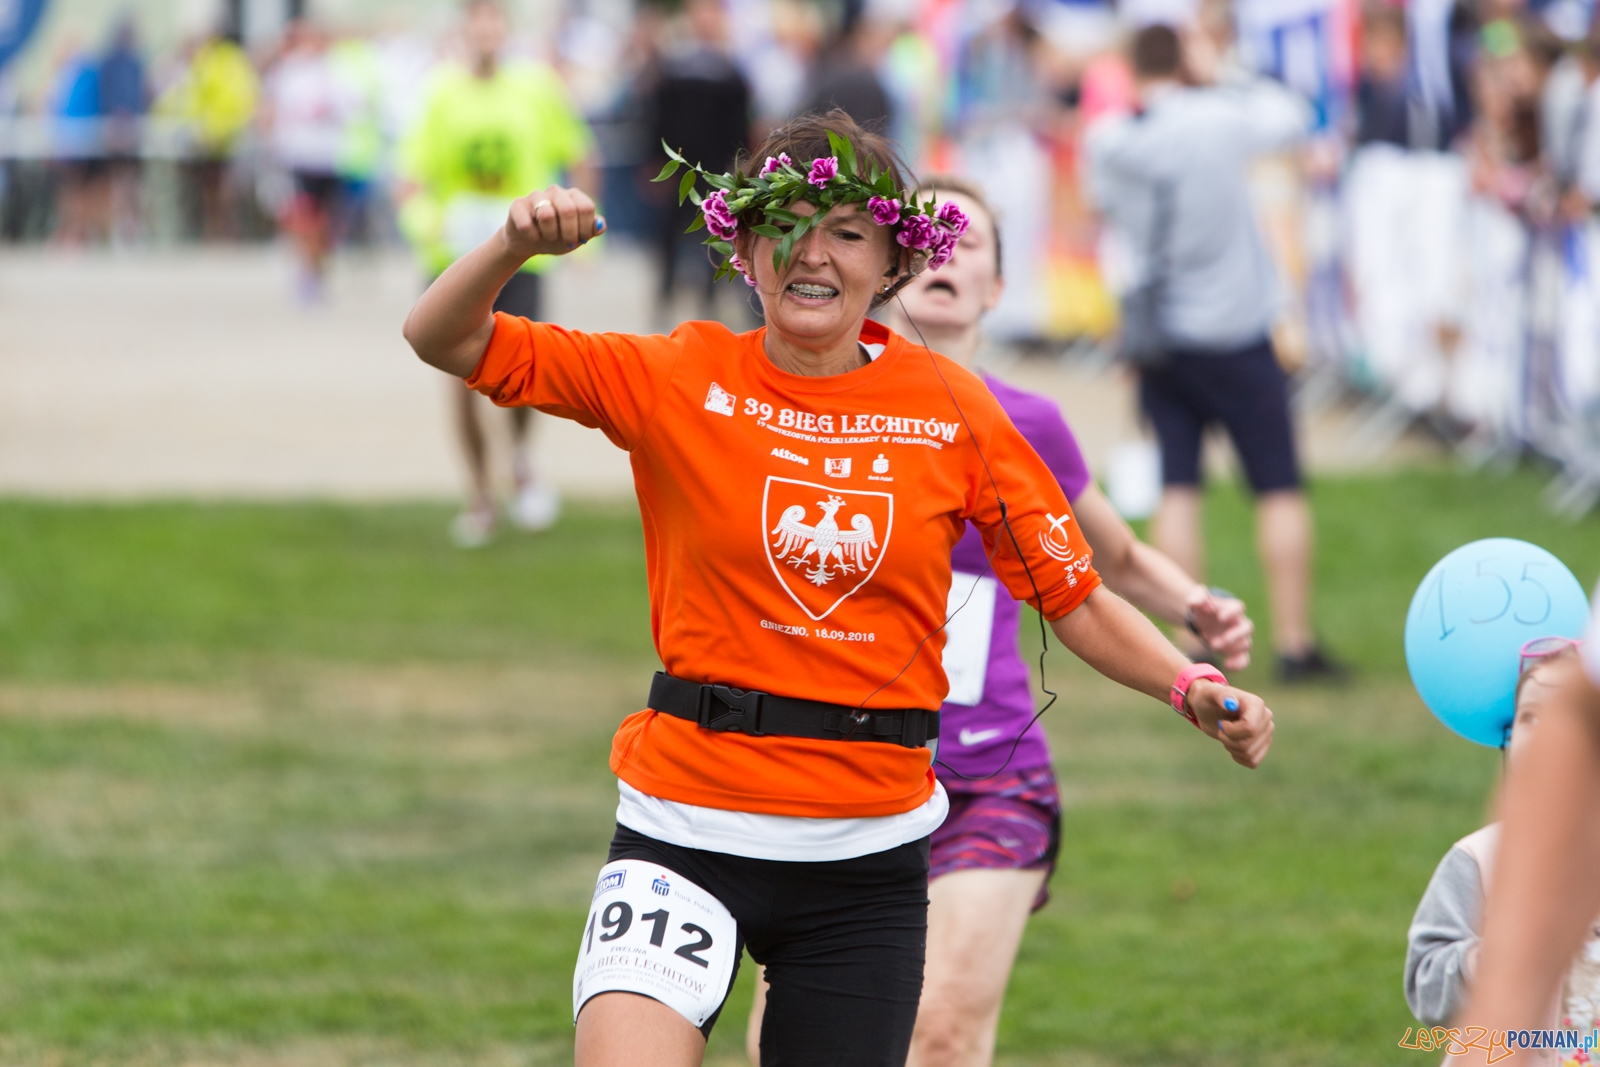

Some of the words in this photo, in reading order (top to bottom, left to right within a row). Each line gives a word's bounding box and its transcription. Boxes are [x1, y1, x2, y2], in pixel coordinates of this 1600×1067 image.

[743, 397, 774, 421] 39
[778, 408, 835, 434] BIEG
[840, 414, 960, 443] LECHITÓW
[766, 424, 816, 443] MISTRZOSTWA
[817, 436, 843, 444] POLSKI
[844, 435, 880, 444] LEKARZY
[882, 435, 890, 443] W
[760, 619, 809, 637] GNIEZNO,
[814, 628, 875, 642] 18.09.2016
[585, 901, 713, 969] 1912
[610, 946, 647, 955] EWELINA
[596, 955, 630, 969] BIEG
[633, 957, 708, 994] LECHITÓW
